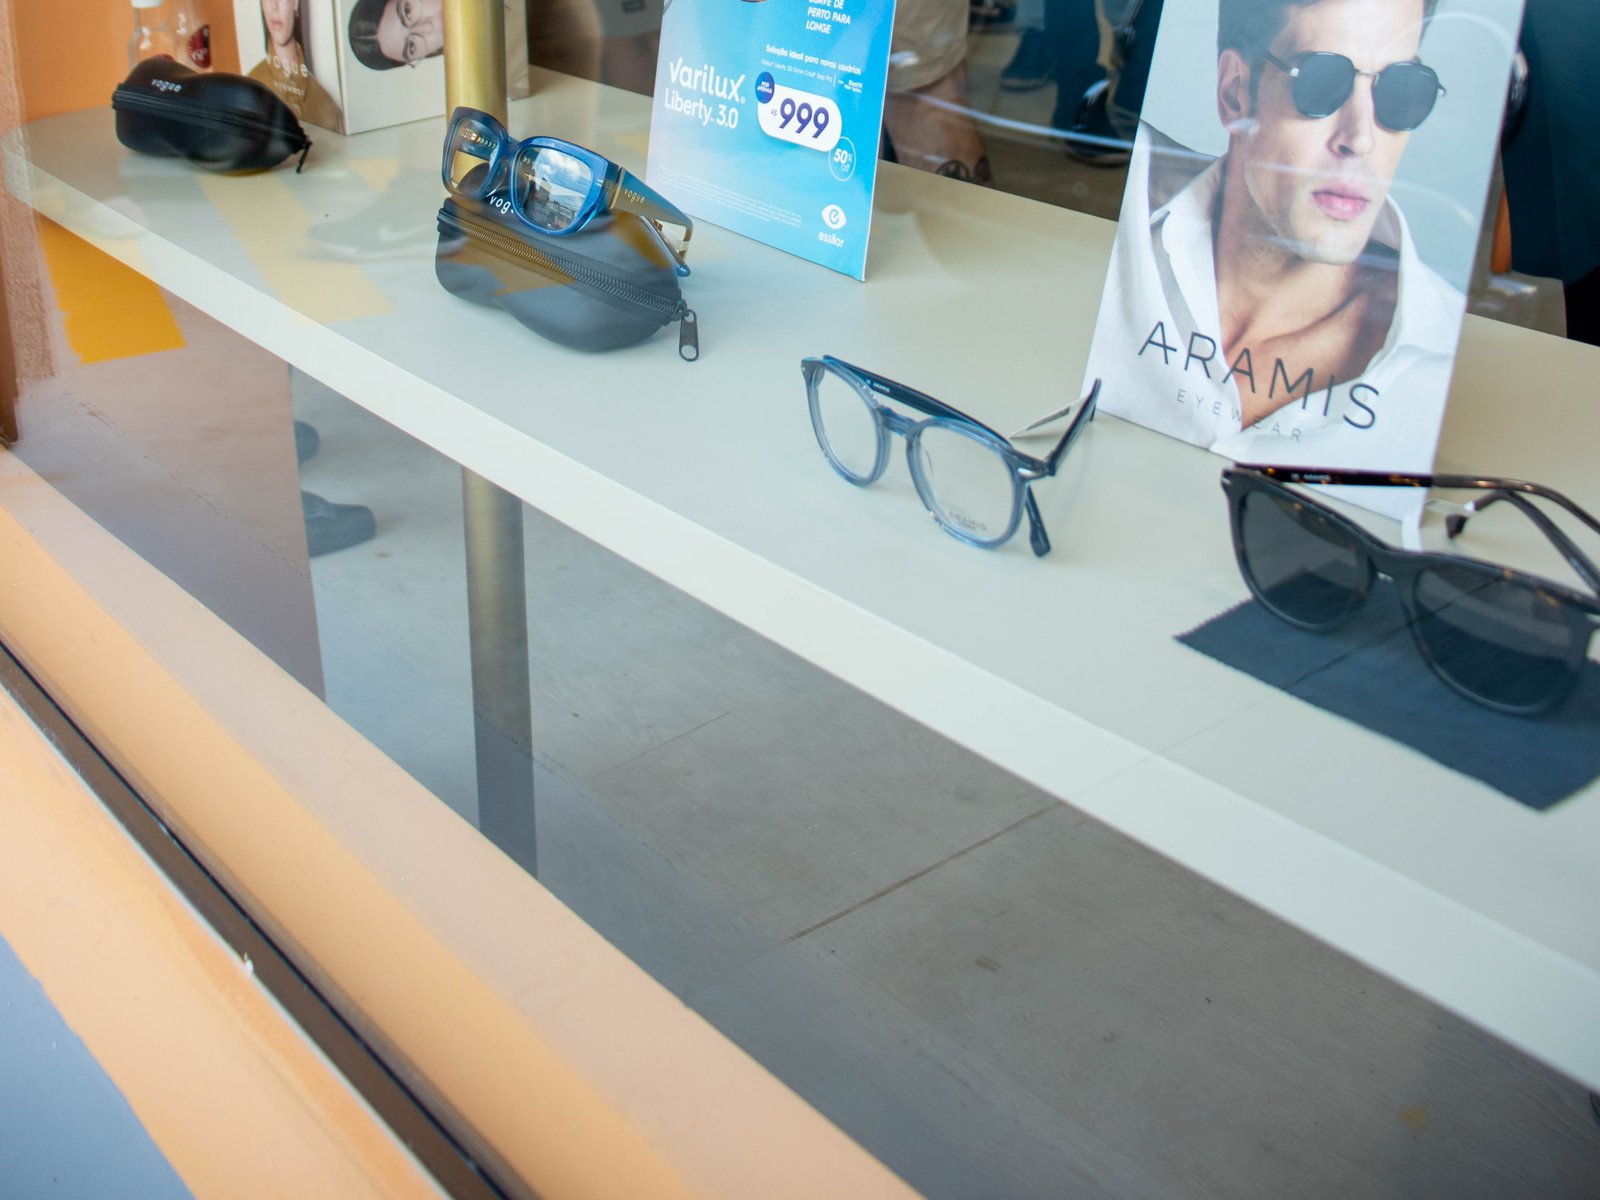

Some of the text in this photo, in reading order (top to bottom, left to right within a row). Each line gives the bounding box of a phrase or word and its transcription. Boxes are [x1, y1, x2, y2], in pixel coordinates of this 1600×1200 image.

[807, 6, 851, 25] PERTO PARA
[805, 20, 832, 34] LONGE
[151, 79, 182, 92] vogue
[664, 88, 739, 129] Liberty 3.0
[779, 98, 830, 139] 999
[490, 195, 514, 215] vog
[624, 188, 645, 204] vogue
[818, 231, 845, 247] essilor
[1138, 321, 1380, 430] ARAMIS
